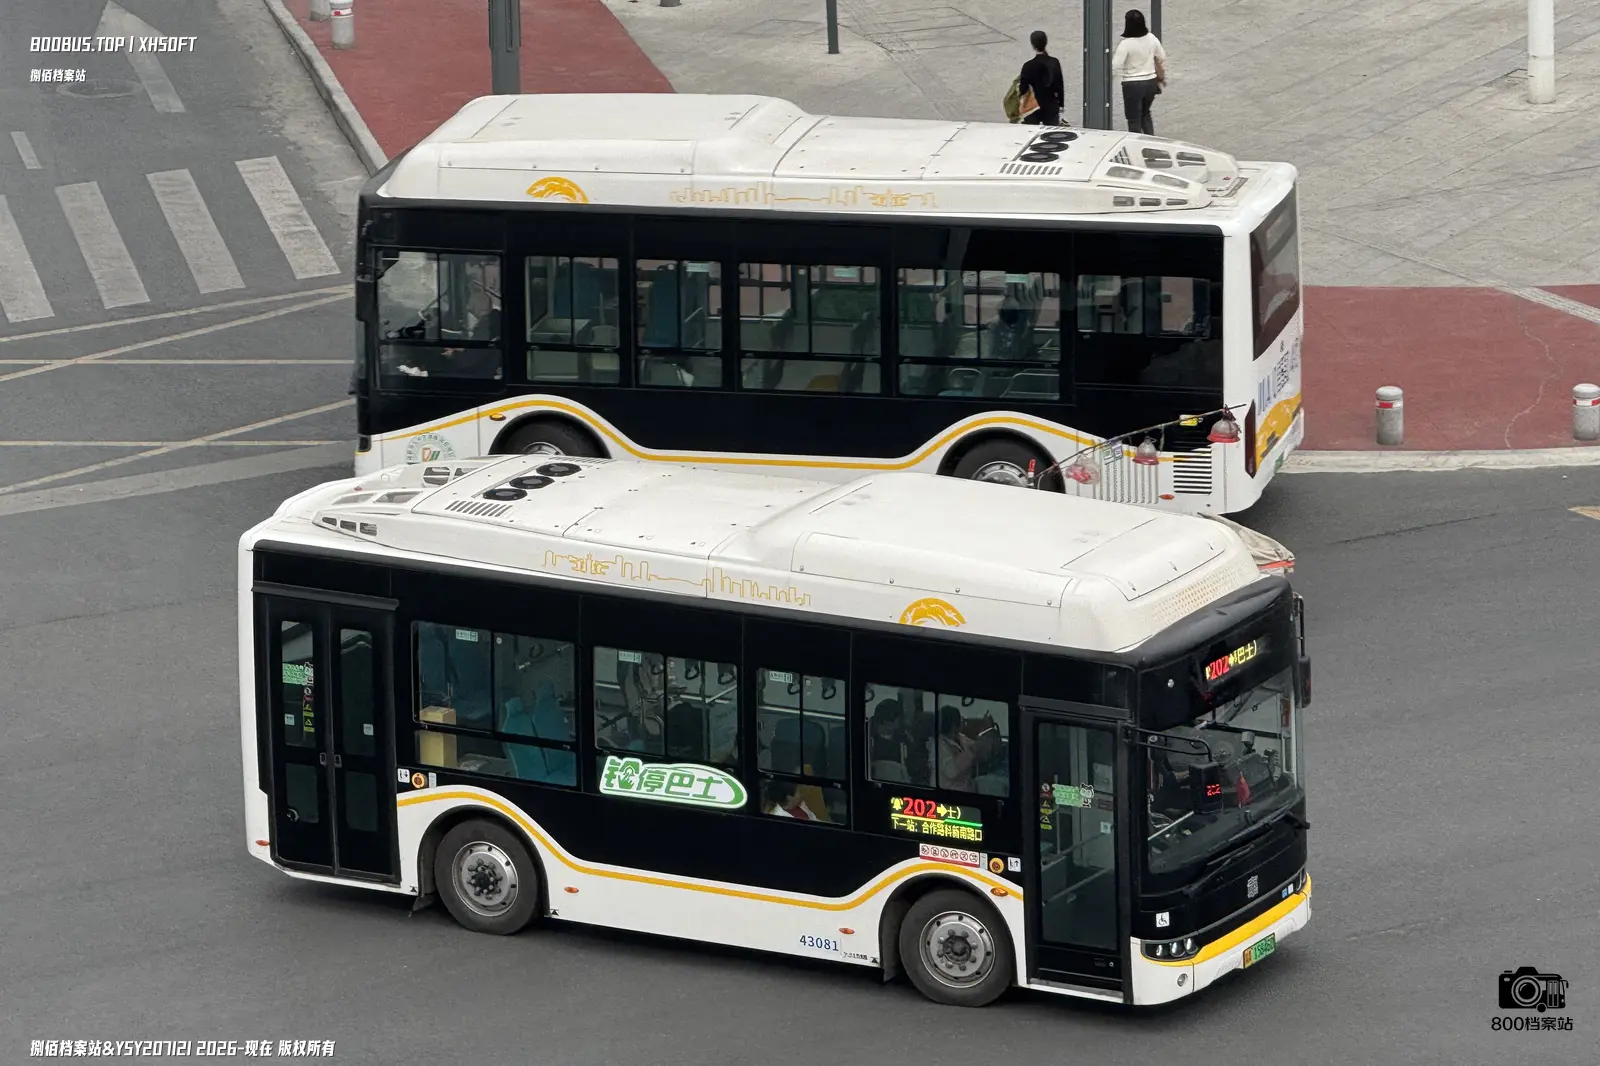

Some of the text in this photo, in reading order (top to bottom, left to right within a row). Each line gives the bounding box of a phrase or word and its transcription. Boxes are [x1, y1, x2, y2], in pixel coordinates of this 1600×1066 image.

[1209, 655, 1230, 680] 202
[903, 796, 937, 819] 202
[799, 934, 840, 952] 43081
